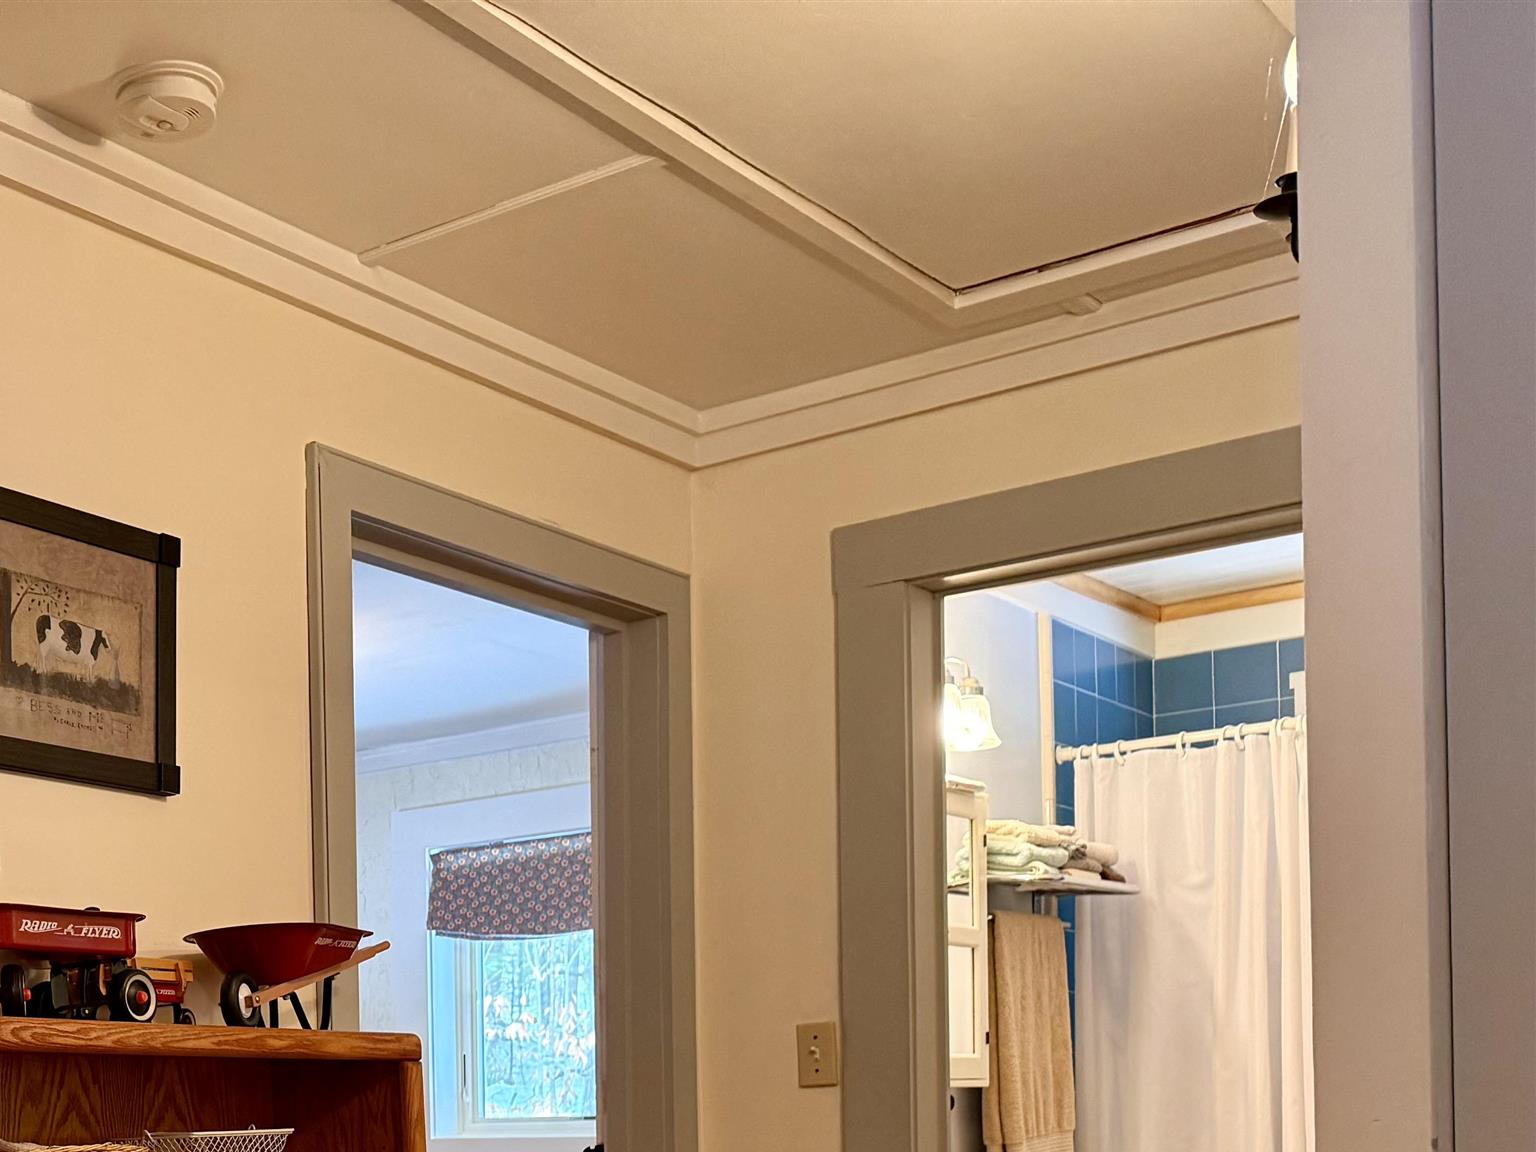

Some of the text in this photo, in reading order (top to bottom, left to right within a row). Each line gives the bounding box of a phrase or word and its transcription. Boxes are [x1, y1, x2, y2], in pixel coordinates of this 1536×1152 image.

[30, 698, 62, 714] BESS
[19, 919, 122, 939] RADIO FLYER
